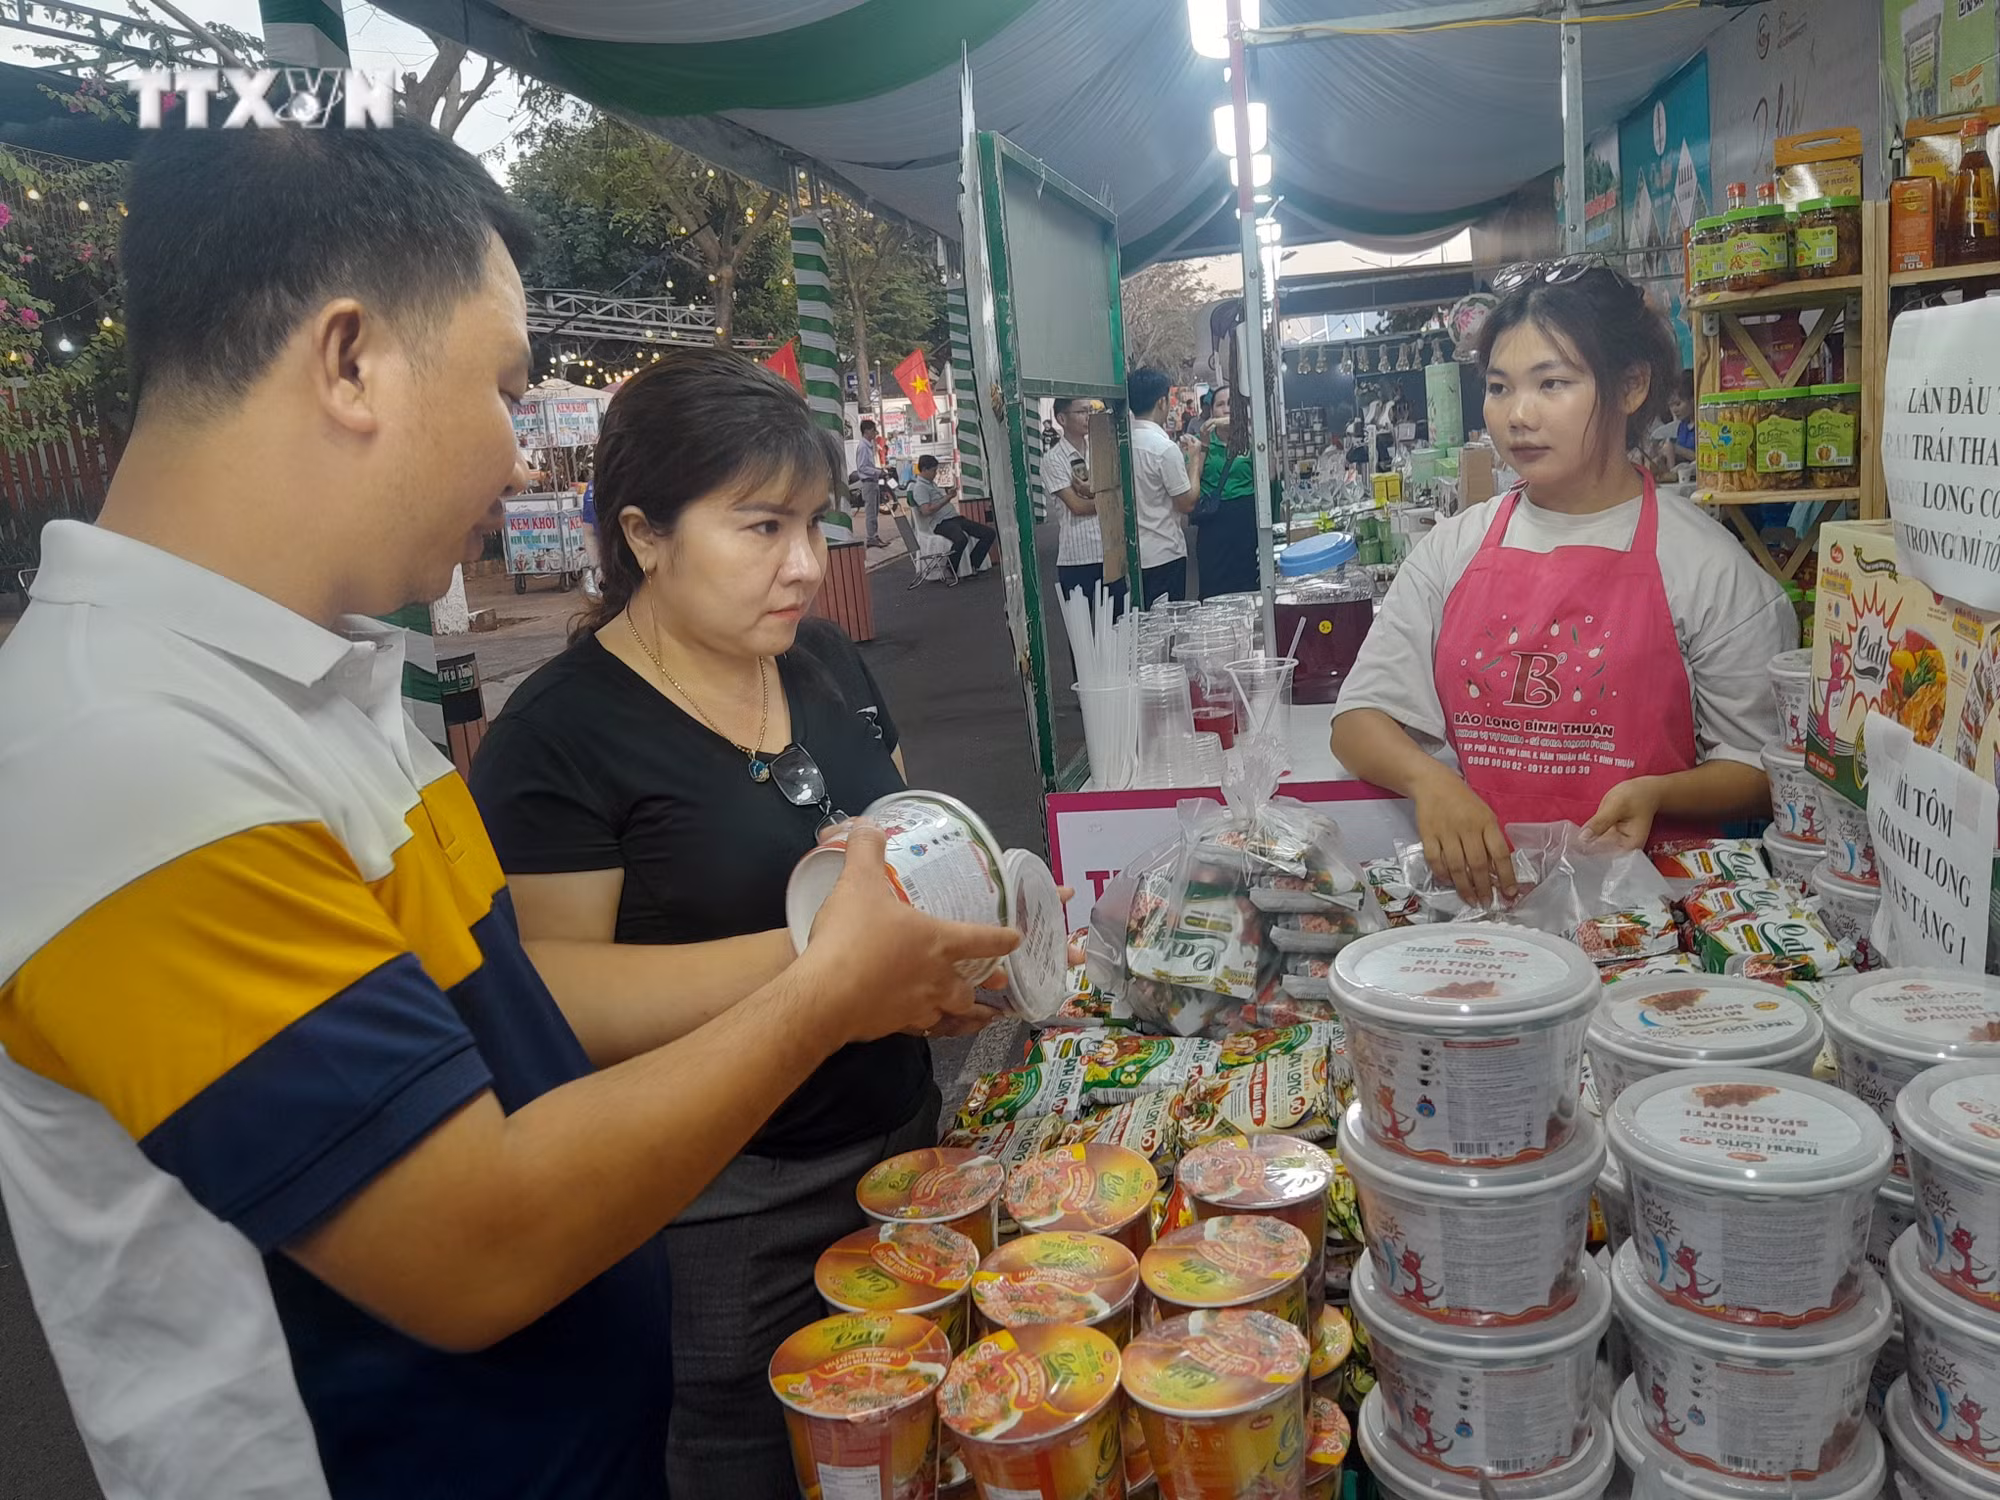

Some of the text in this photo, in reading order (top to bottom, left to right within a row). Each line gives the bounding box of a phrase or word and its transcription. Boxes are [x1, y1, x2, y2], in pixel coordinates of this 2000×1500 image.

[1912, 426, 1953, 463] TRÁI
[1923, 482, 1975, 515] LONG
[1903, 523, 1955, 561] TRONG
[1960, 529, 1981, 567] MÌ
[1856, 625, 1889, 684] Caty
[1485, 715, 1521, 731] LONG
[1524, 719, 1559, 734] BÌNH
[1562, 722, 1615, 739] THUẬN
[1913, 787, 1953, 838] TÔM
[1925, 847, 1972, 909] LONG
[1909, 892, 1954, 955] TẶNG
[1399, 966, 1517, 979] SPAGHETTI
[1904, 1011, 2000, 1022] SPAGHETT
[1684, 1110, 1808, 1128] SPAGHETTI
